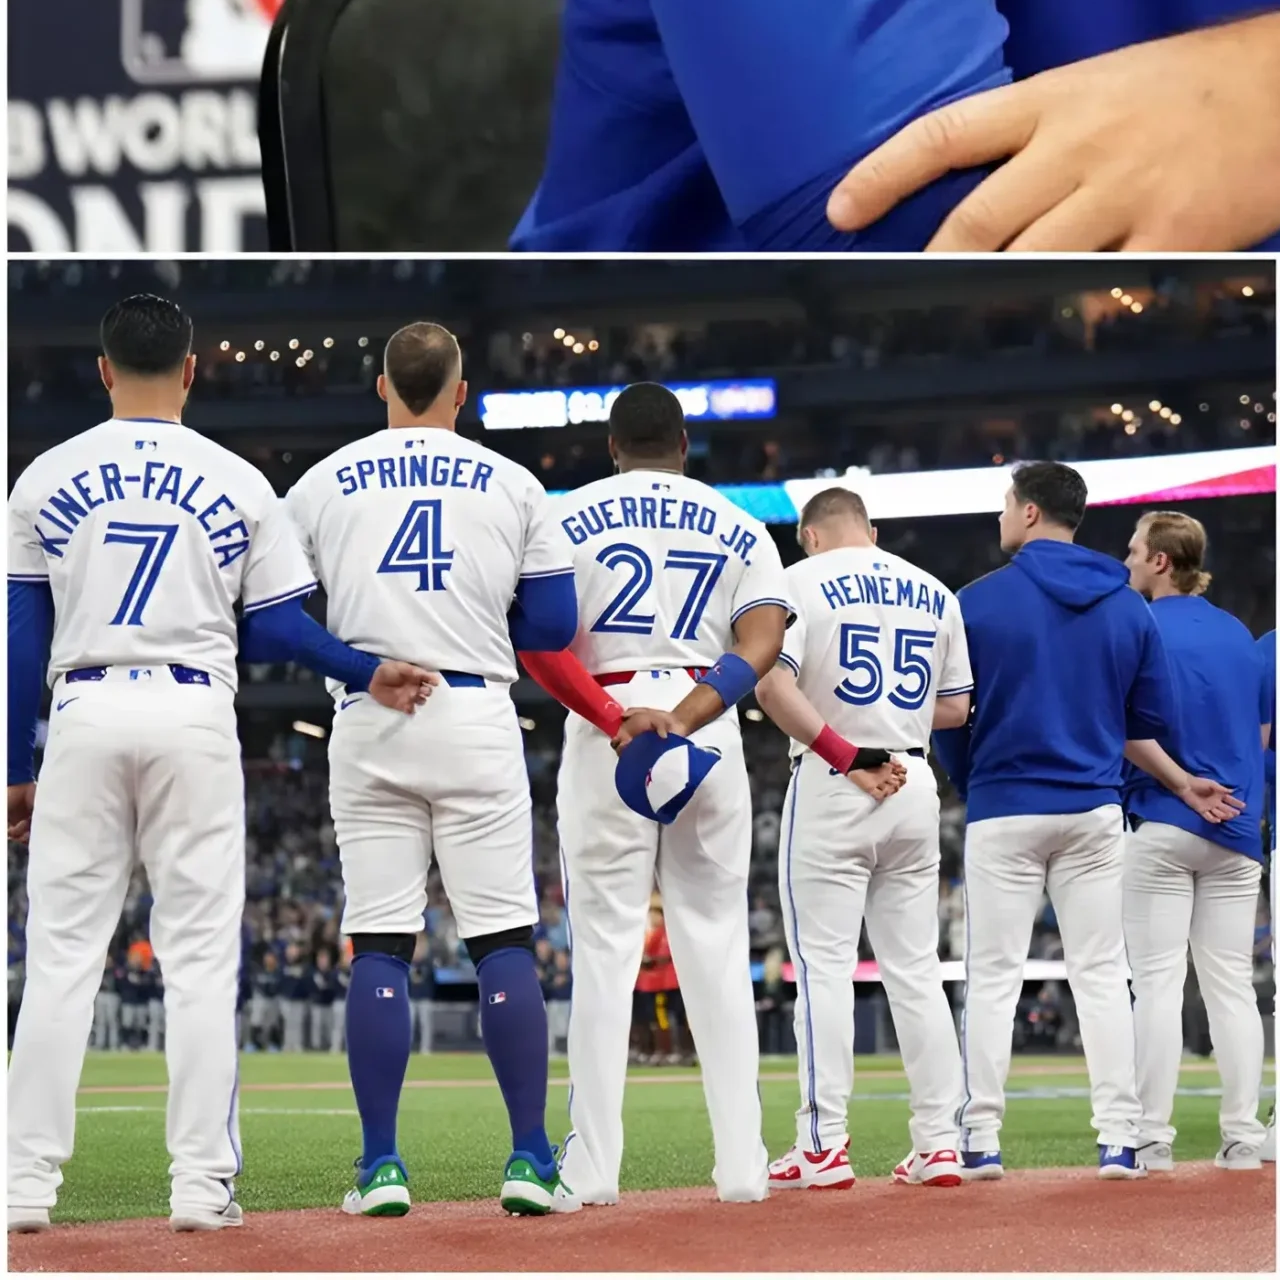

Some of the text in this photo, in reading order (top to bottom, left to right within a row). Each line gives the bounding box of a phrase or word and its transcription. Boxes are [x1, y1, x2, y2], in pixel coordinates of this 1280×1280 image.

[35, 461, 250, 569] KINER-FALEFA
[336, 454, 494, 497] SPRINGER
[103, 521, 180, 626] 7
[376, 499, 455, 592] 4
[561, 496, 758, 567] GUERRERO JR.
[590, 542, 729, 641] 27
[820, 574, 947, 621] HEINEMAN
[833, 623, 938, 710] 55
